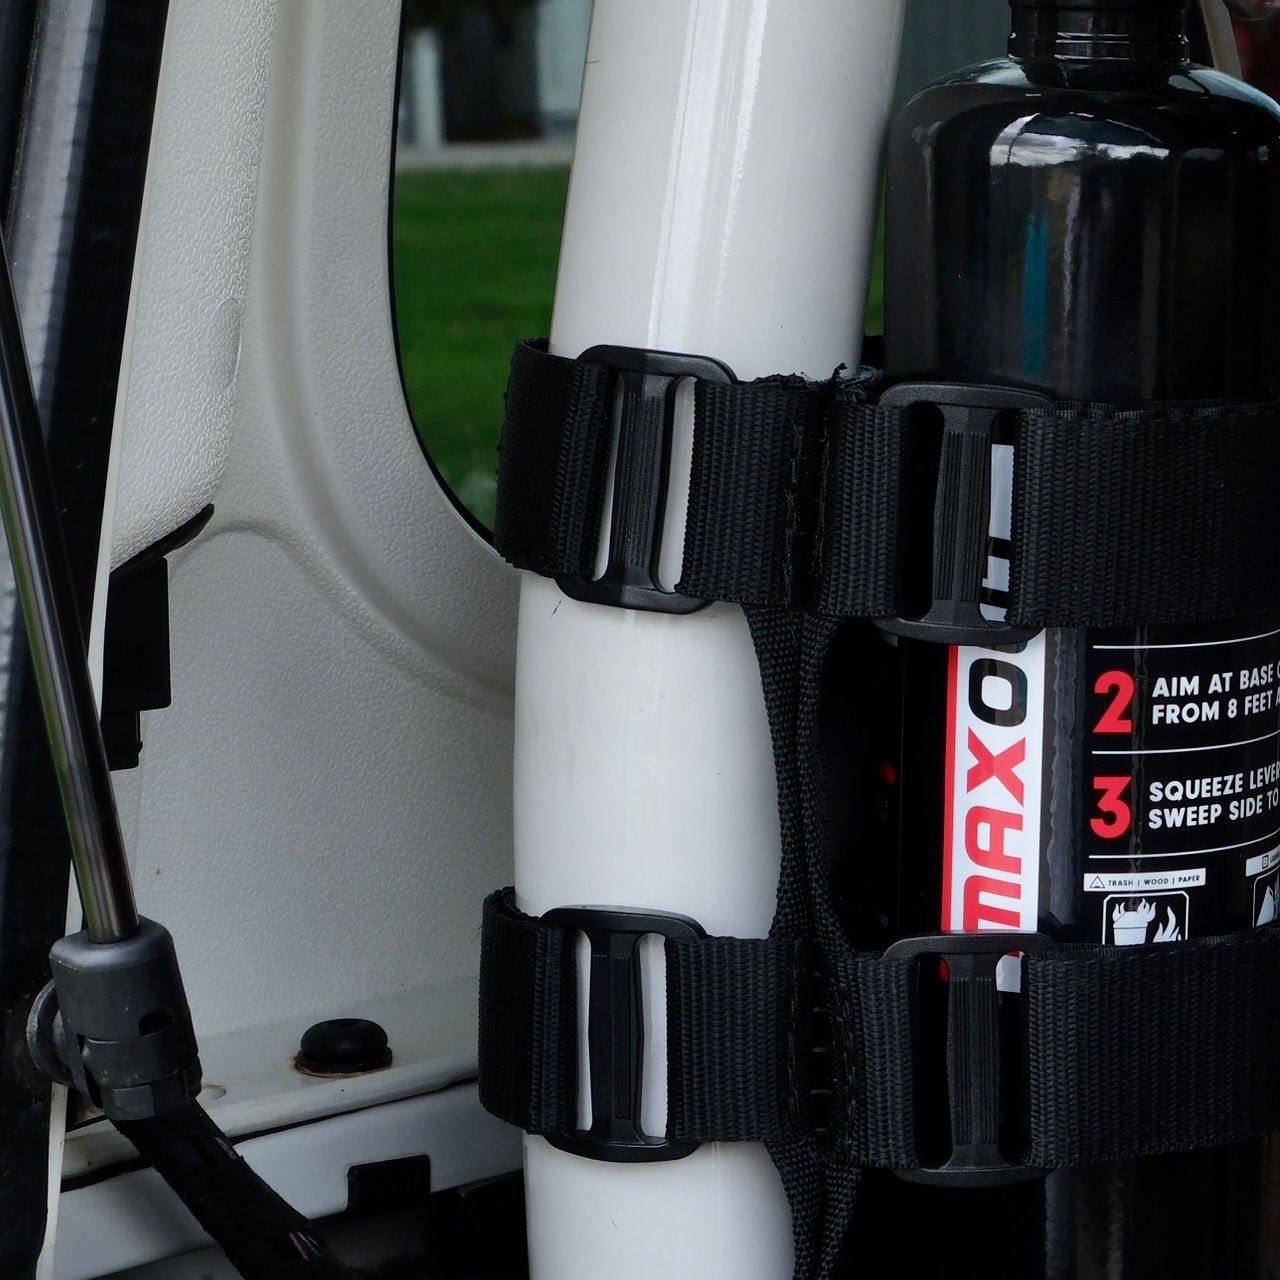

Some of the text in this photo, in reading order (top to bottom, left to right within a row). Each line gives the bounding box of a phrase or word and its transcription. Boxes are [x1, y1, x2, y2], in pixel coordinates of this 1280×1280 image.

[1094, 670, 1135, 733] 2
[1152, 676, 1200, 698] AIM
[1208, 671, 1233, 694] AT
[1239, 663, 1274, 690] BASE
[1152, 701, 1220, 725] FROM
[1228, 699, 1238, 719] 8
[1244, 689, 1273, 716] FEET
[1149, 760, 1280, 803] SQUEEZE LEVER
[1089, 776, 1132, 839] 3
[1148, 803, 1222, 830] SWEEP
[1229, 794, 1263, 821] SIDE
[1266, 787, 1279, 810] TO
[1108, 874, 1201, 887] TRASH WOOD PAPER
